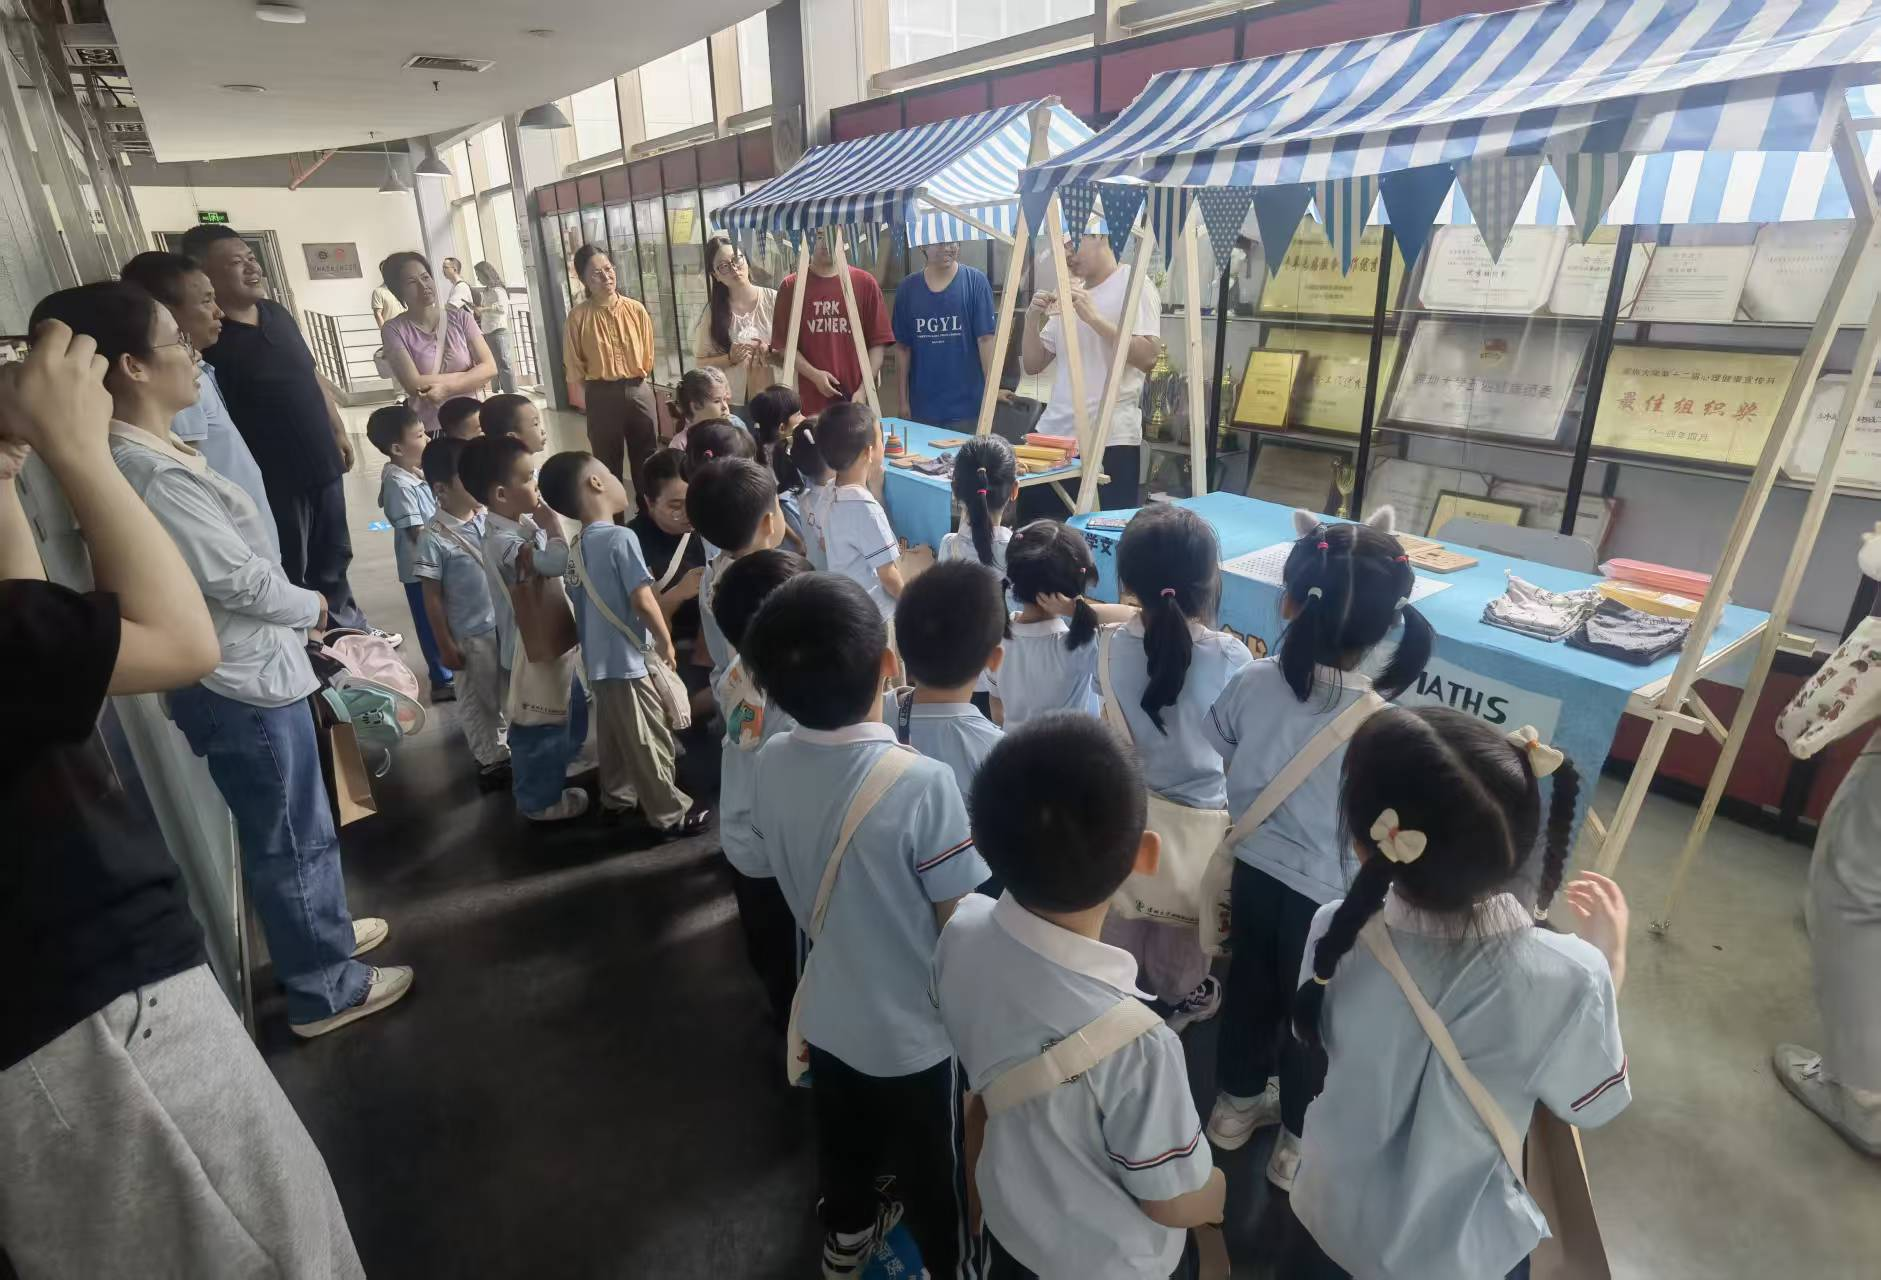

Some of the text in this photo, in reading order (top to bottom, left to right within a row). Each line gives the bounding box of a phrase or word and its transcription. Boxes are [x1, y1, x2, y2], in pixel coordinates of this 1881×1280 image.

[813, 300, 841, 315] TRK
[916, 315, 962, 333] PGYL
[1617, 391, 1760, 422] 最佳组织奖
